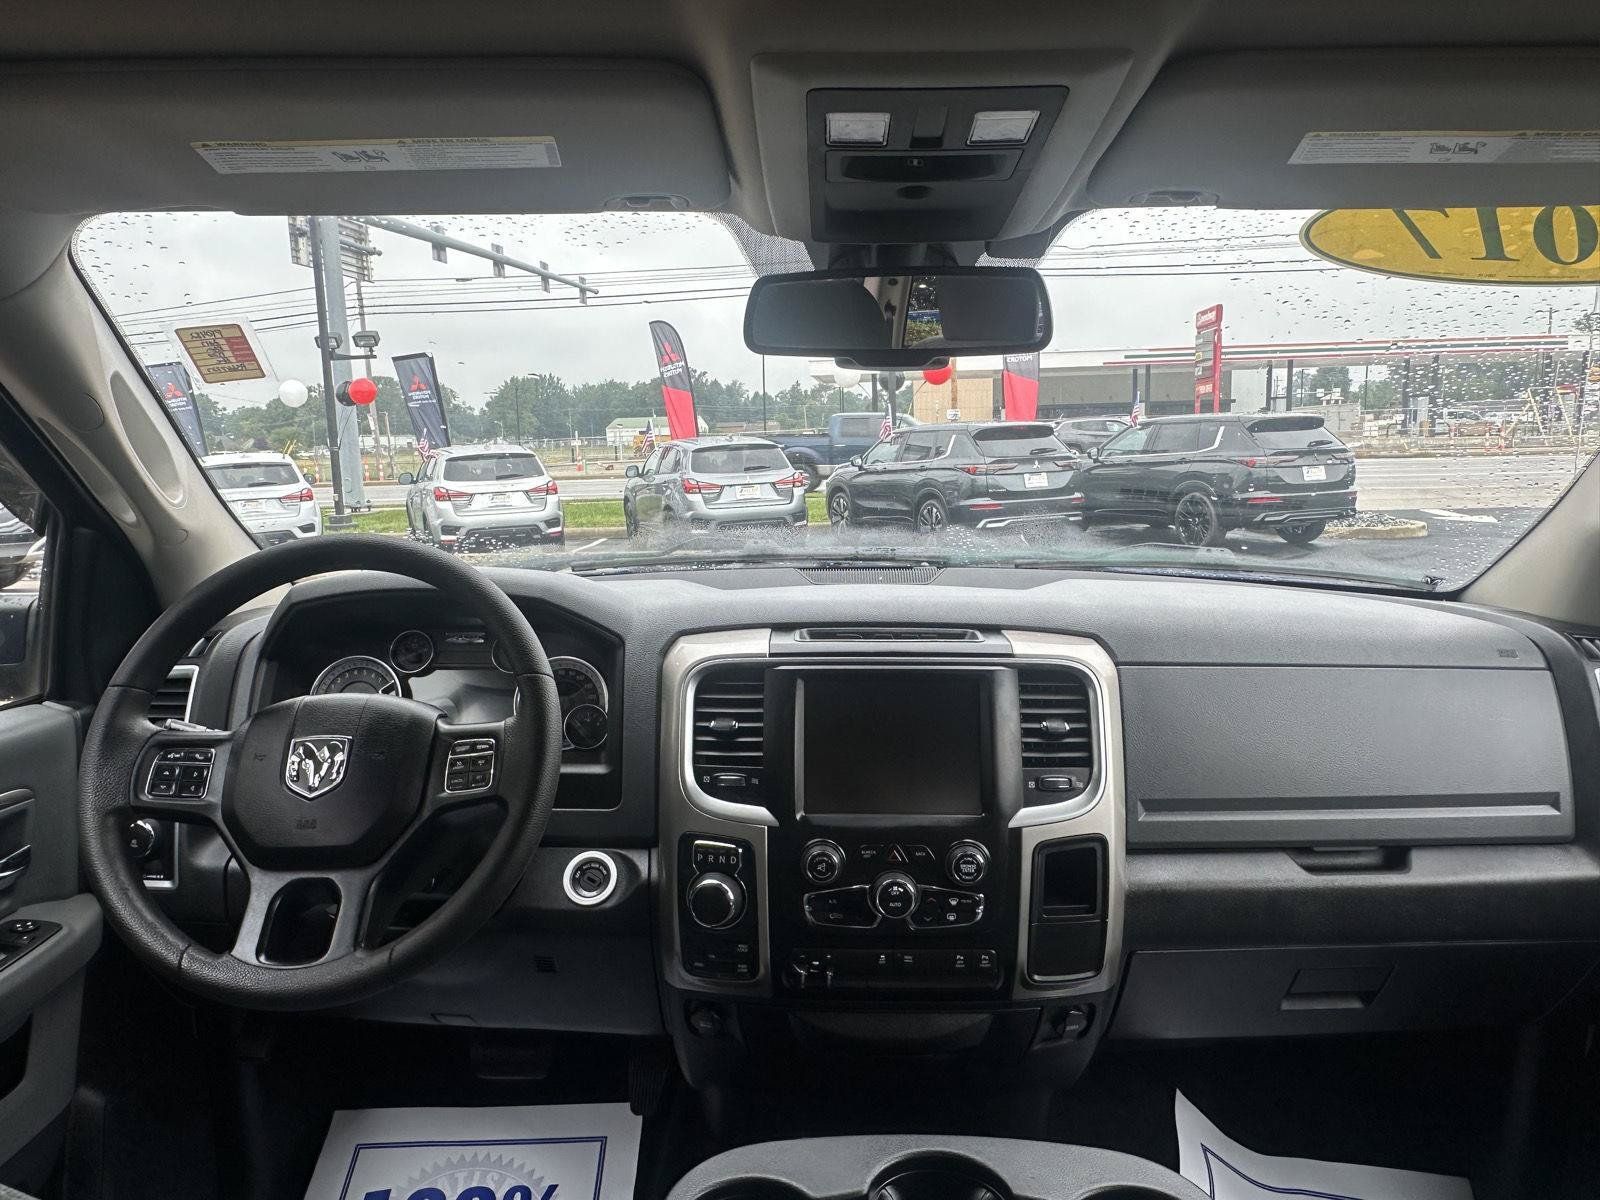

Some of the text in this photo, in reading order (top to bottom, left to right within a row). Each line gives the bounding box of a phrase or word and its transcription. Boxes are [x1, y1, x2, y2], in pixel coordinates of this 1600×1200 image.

[697, 853, 737, 864] P R N D
